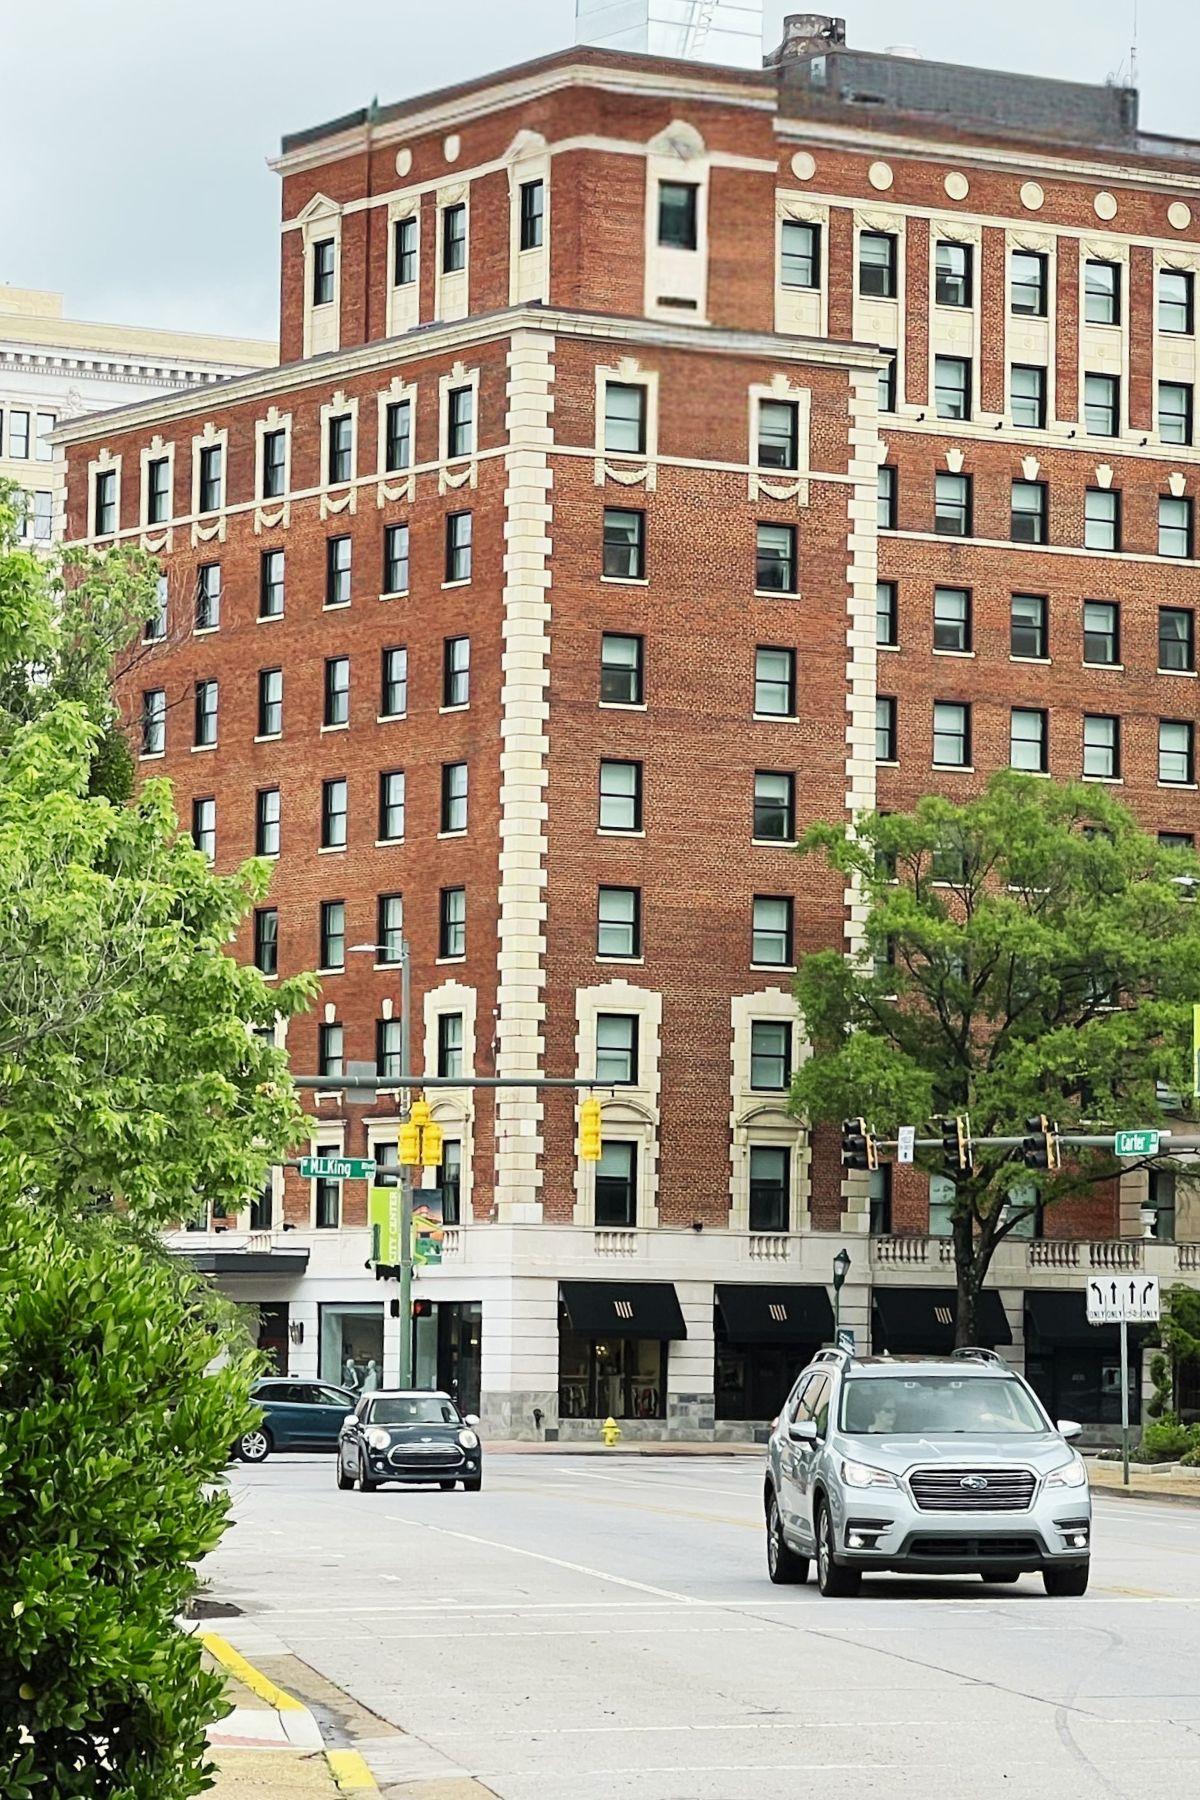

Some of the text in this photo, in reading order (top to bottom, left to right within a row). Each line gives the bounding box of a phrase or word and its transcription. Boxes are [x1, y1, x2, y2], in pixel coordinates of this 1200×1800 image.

[1121, 1134, 1146, 1151] Carter
[1090, 1311, 1157, 1319] ONLY ONLY ONLY
